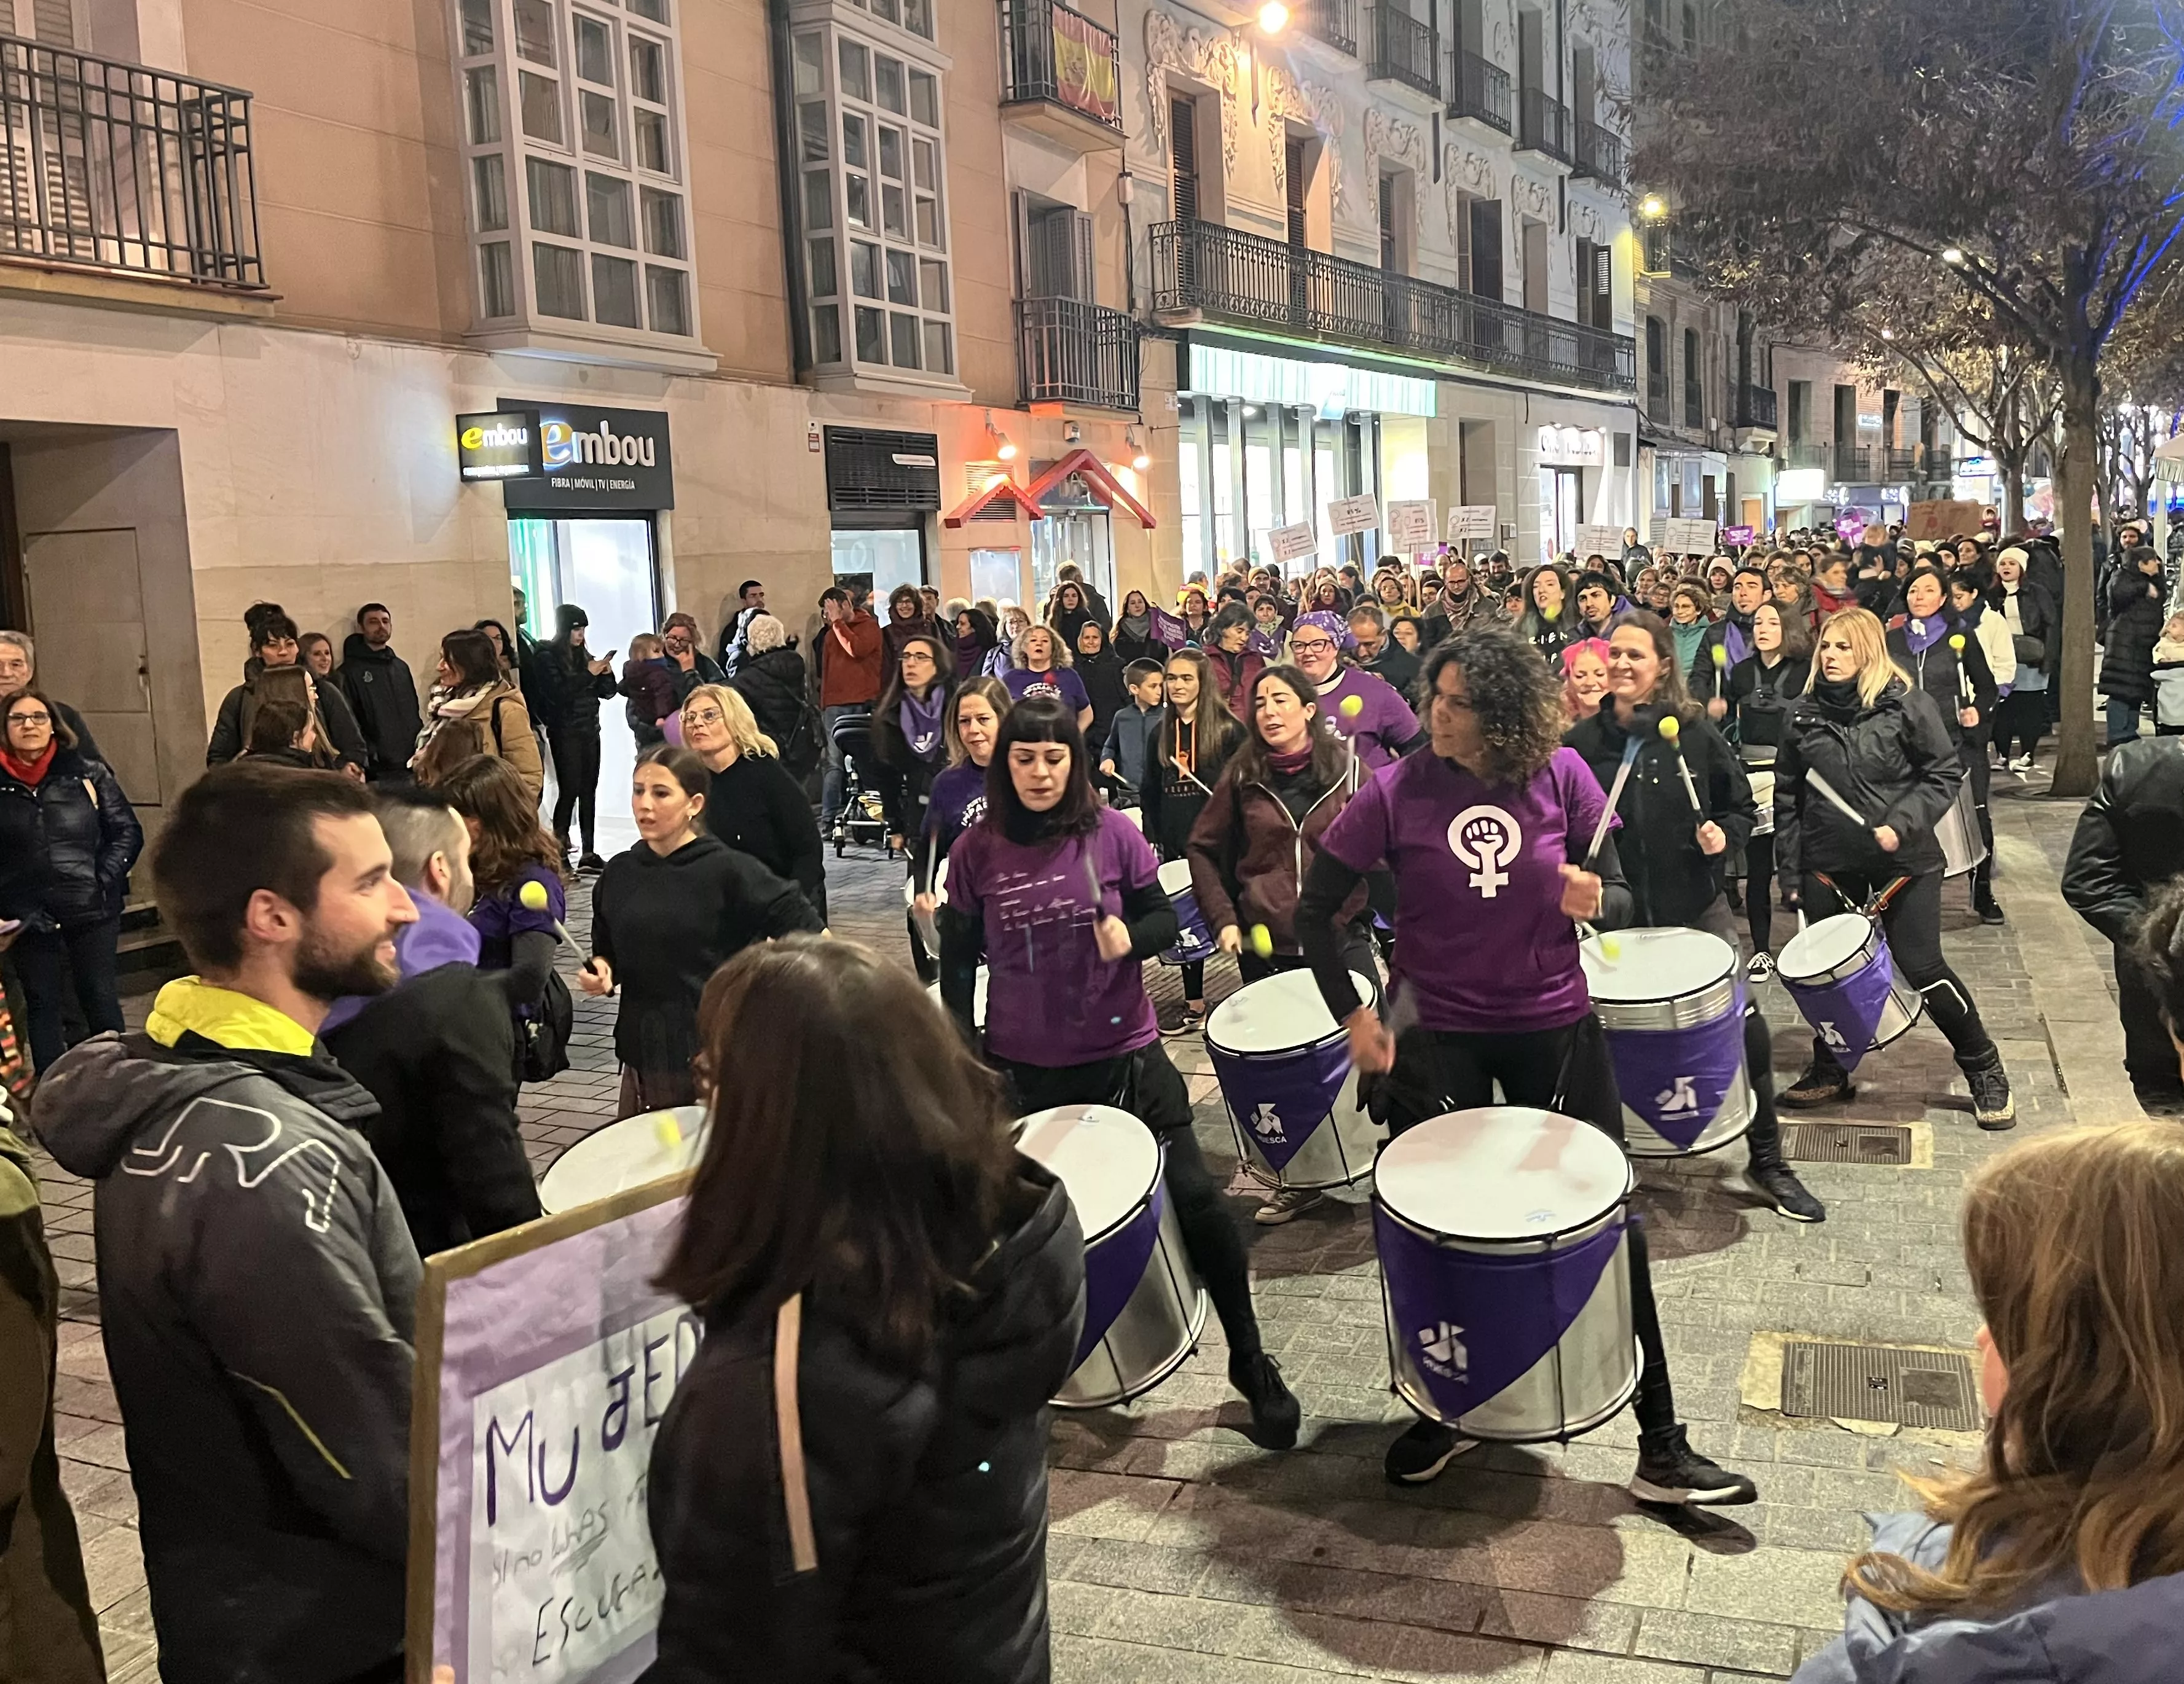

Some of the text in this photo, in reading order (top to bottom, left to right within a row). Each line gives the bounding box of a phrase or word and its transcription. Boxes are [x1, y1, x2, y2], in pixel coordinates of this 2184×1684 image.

[461, 422, 528, 450] embou
[540, 420, 656, 469] embou
[552, 476, 635, 490] FIBRA MÓVIL TV ENERGÍA
